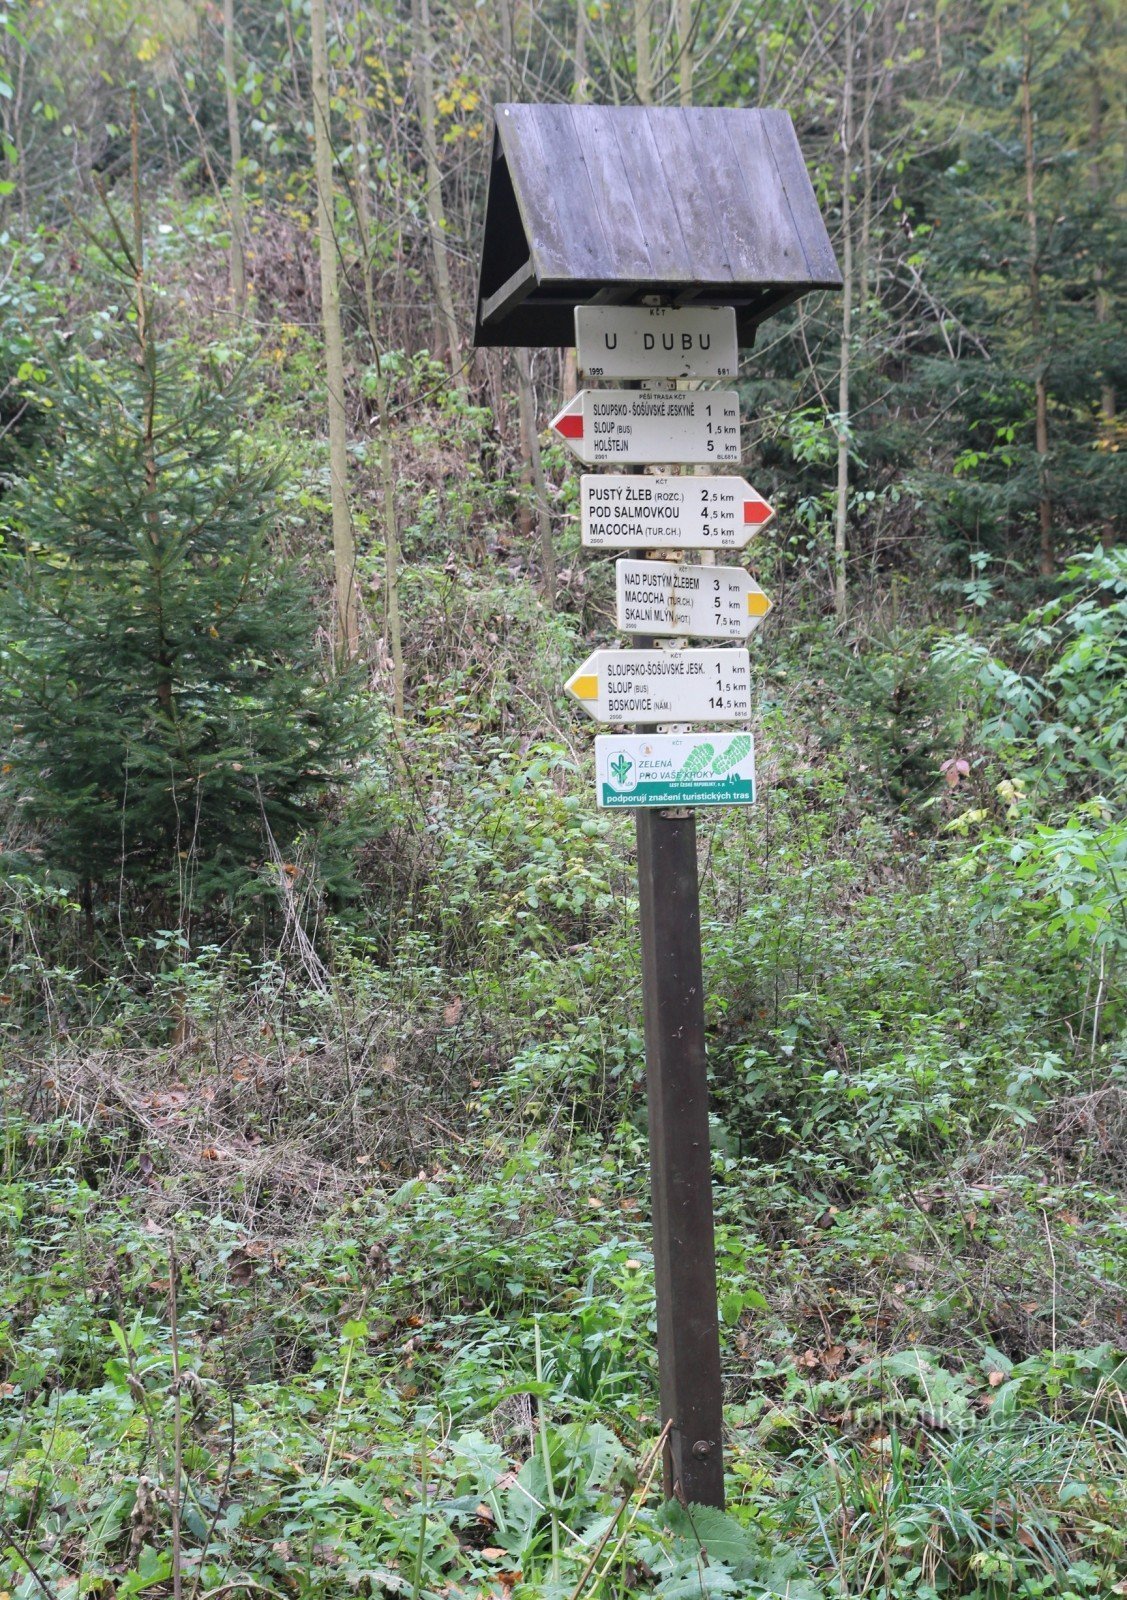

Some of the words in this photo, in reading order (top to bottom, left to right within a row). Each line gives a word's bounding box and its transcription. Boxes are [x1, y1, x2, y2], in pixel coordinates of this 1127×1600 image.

[604, 333, 617, 350] U
[644, 333, 711, 350] DUBU
[589, 368, 604, 376] 1993
[593, 404, 627, 416] SLOUPSKO
[706, 405, 712, 416] 1
[594, 422, 615, 434] SLOUP
[616, 425, 632, 435] (BUS)
[724, 426, 736, 434] km
[594, 438, 628, 451] HOLŠTEJN
[707, 440, 714, 451] 5
[589, 487, 622, 500] PUSTÝ
[626, 487, 652, 500] ŽLEB
[654, 492, 684, 502] (ROZC.)
[590, 506, 611, 518] POD
[615, 506, 680, 518] SALMOVKOU
[590, 524, 643, 535] MACOCHA
[645, 527, 681, 537] (TUR.CH.)
[625, 574, 640, 585] NAD
[642, 573, 672, 587] PUSTÝM
[673, 573, 700, 589] ŽLEBEM
[714, 580, 720, 591] 3
[625, 591, 664, 604] MACOCHA
[714, 597, 720, 608] 5
[626, 608, 652, 621] SKALNÍ
[654, 608, 674, 622] MLÝN
[686, 663, 705, 674] JESK.
[715, 663, 720, 674] 1
[608, 682, 632, 693] SLOUP
[634, 686, 648, 694] (BUS)
[609, 699, 651, 711] BOSKOVICE
[639, 758, 672, 768] ZELENÁ
[660, 770, 682, 779] VAŠE
[607, 794, 647, 803] podporují
[649, 793, 680, 801] značení
[682, 792, 731, 800] turistických
